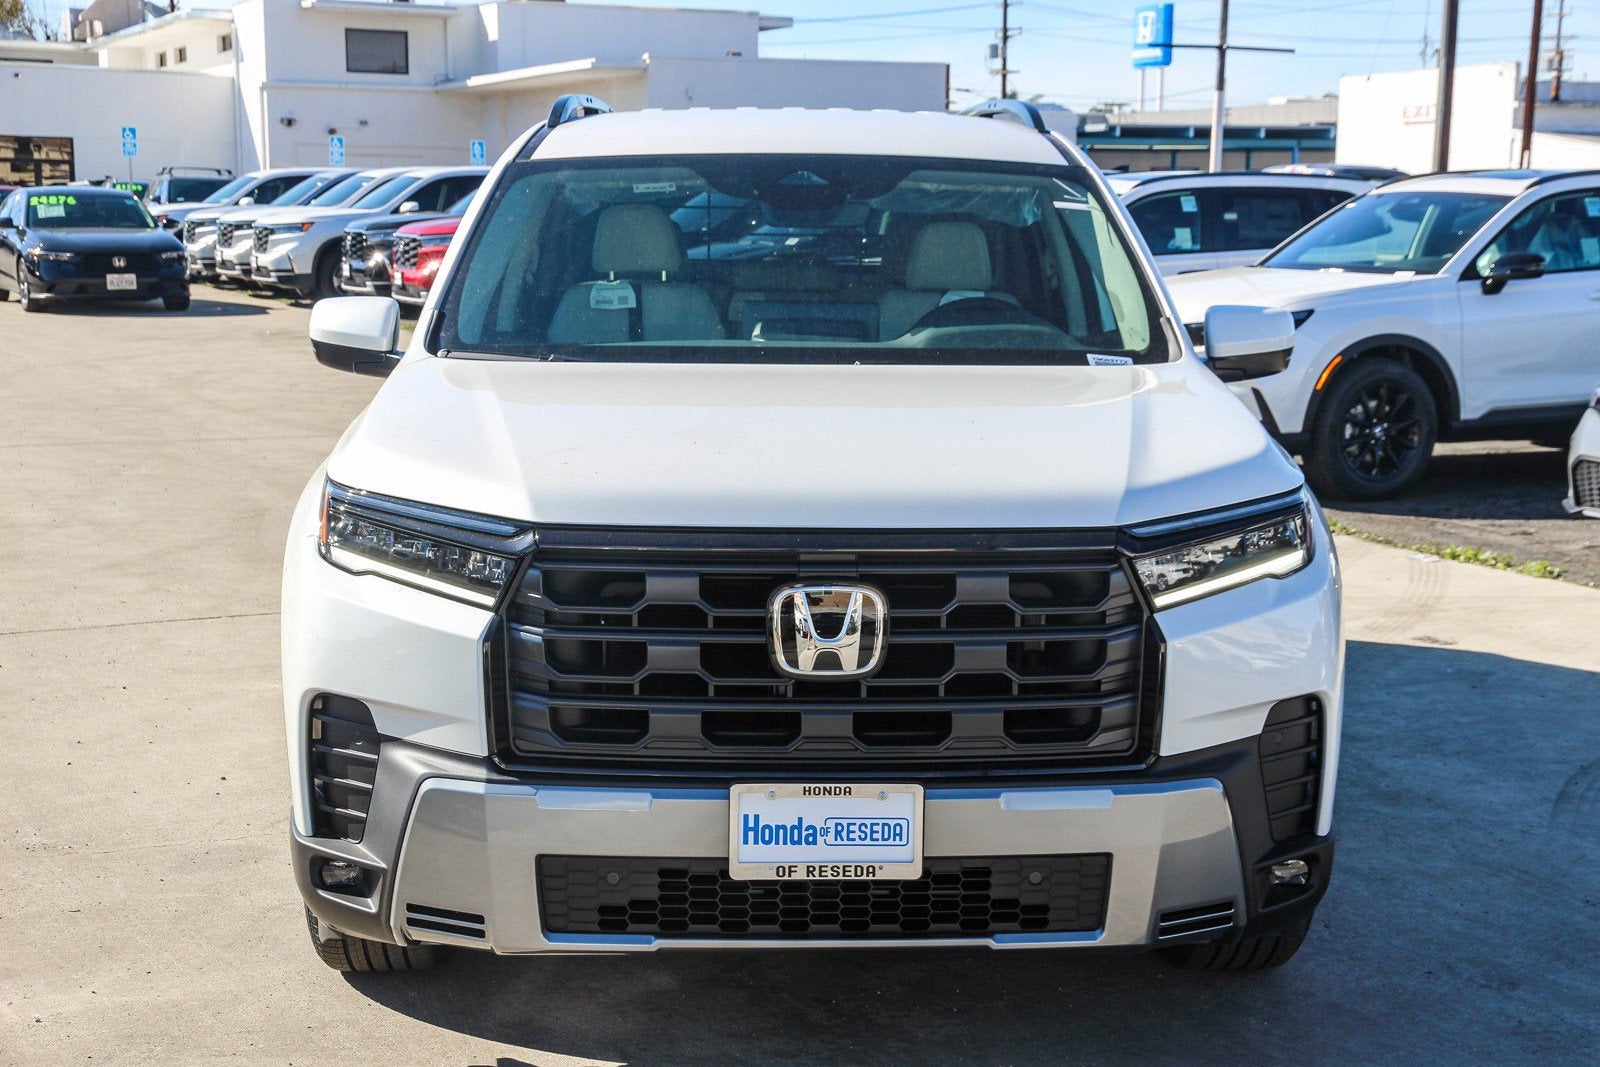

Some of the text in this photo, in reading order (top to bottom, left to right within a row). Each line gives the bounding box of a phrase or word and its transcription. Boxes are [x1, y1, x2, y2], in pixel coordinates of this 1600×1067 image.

[802, 785, 853, 796] HONDA
[742, 813, 904, 846] Honda OF RESEDA
[775, 864, 877, 878] OF RESEDA
